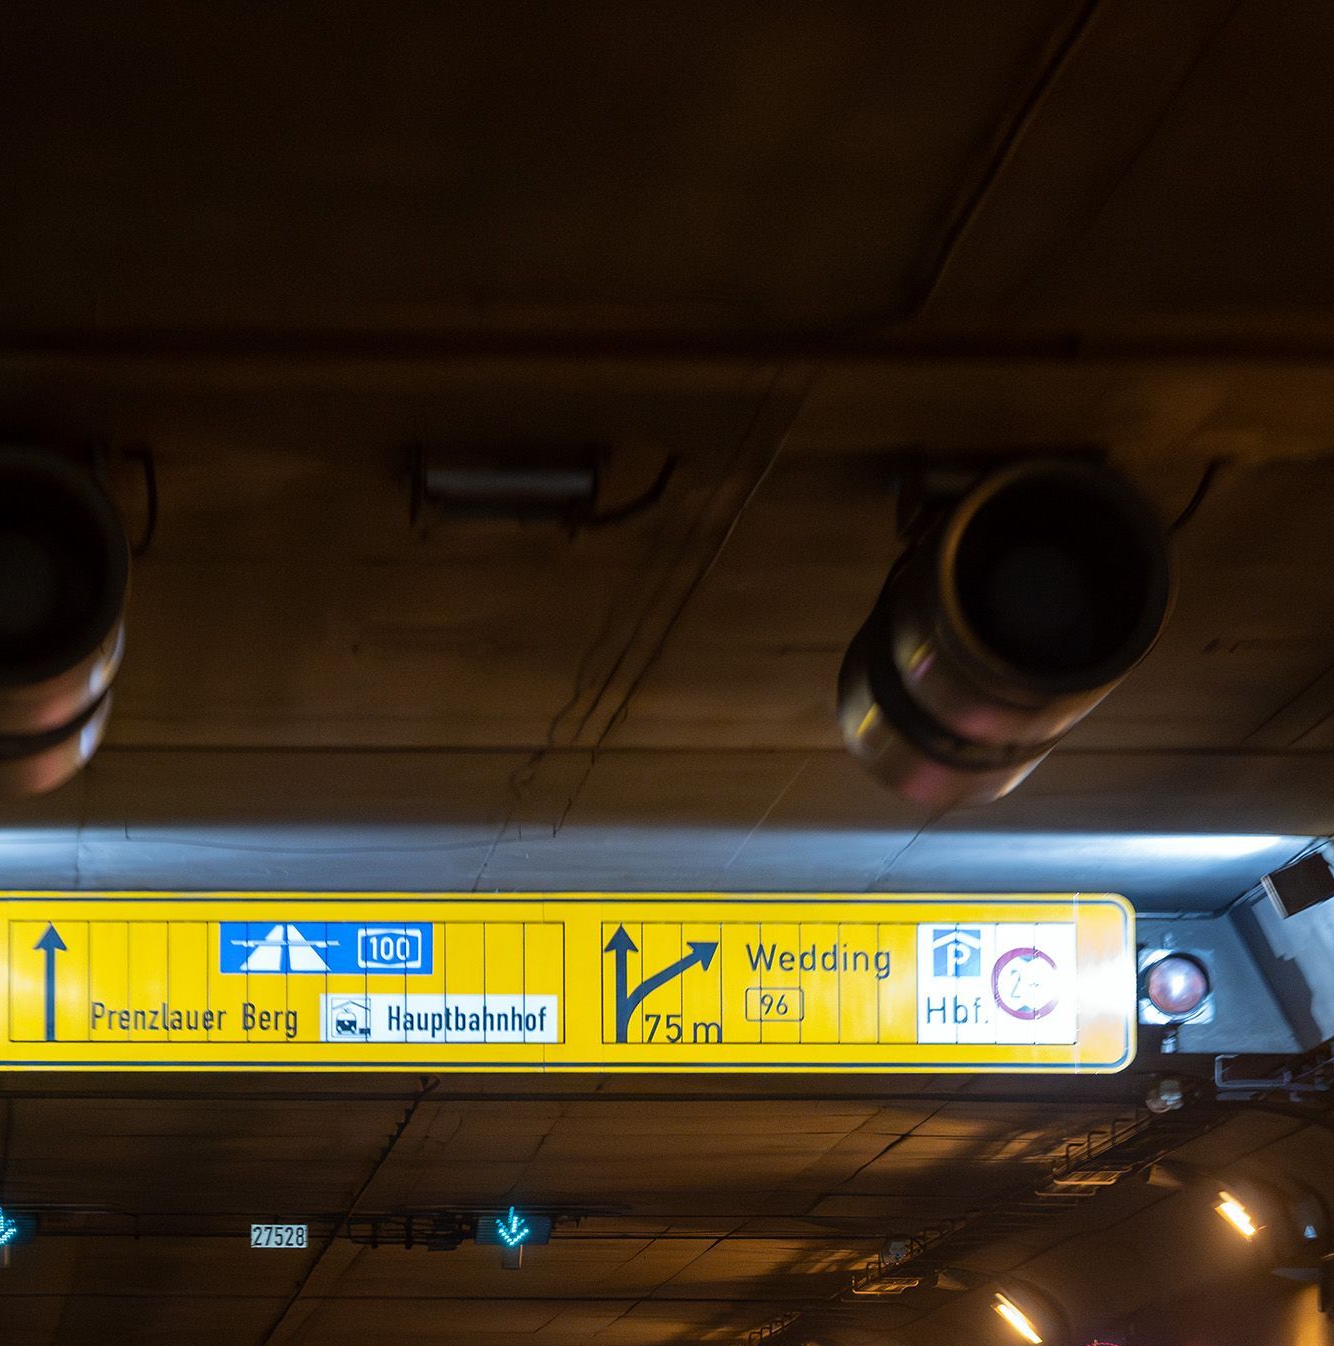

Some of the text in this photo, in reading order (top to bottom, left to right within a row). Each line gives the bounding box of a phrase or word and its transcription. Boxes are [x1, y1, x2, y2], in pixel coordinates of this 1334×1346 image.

[369, 936, 411, 961] 100
[744, 942, 891, 980] Wedding
[760, 993, 789, 1016] 96
[926, 995, 989, 1025] Hbf.
[91, 1001, 299, 1039] Prenzlauer Berg
[387, 1005, 548, 1039] Hauptbahnhof
[644, 1013, 723, 1044] 75 m
[253, 1226, 306, 1247] 27528
